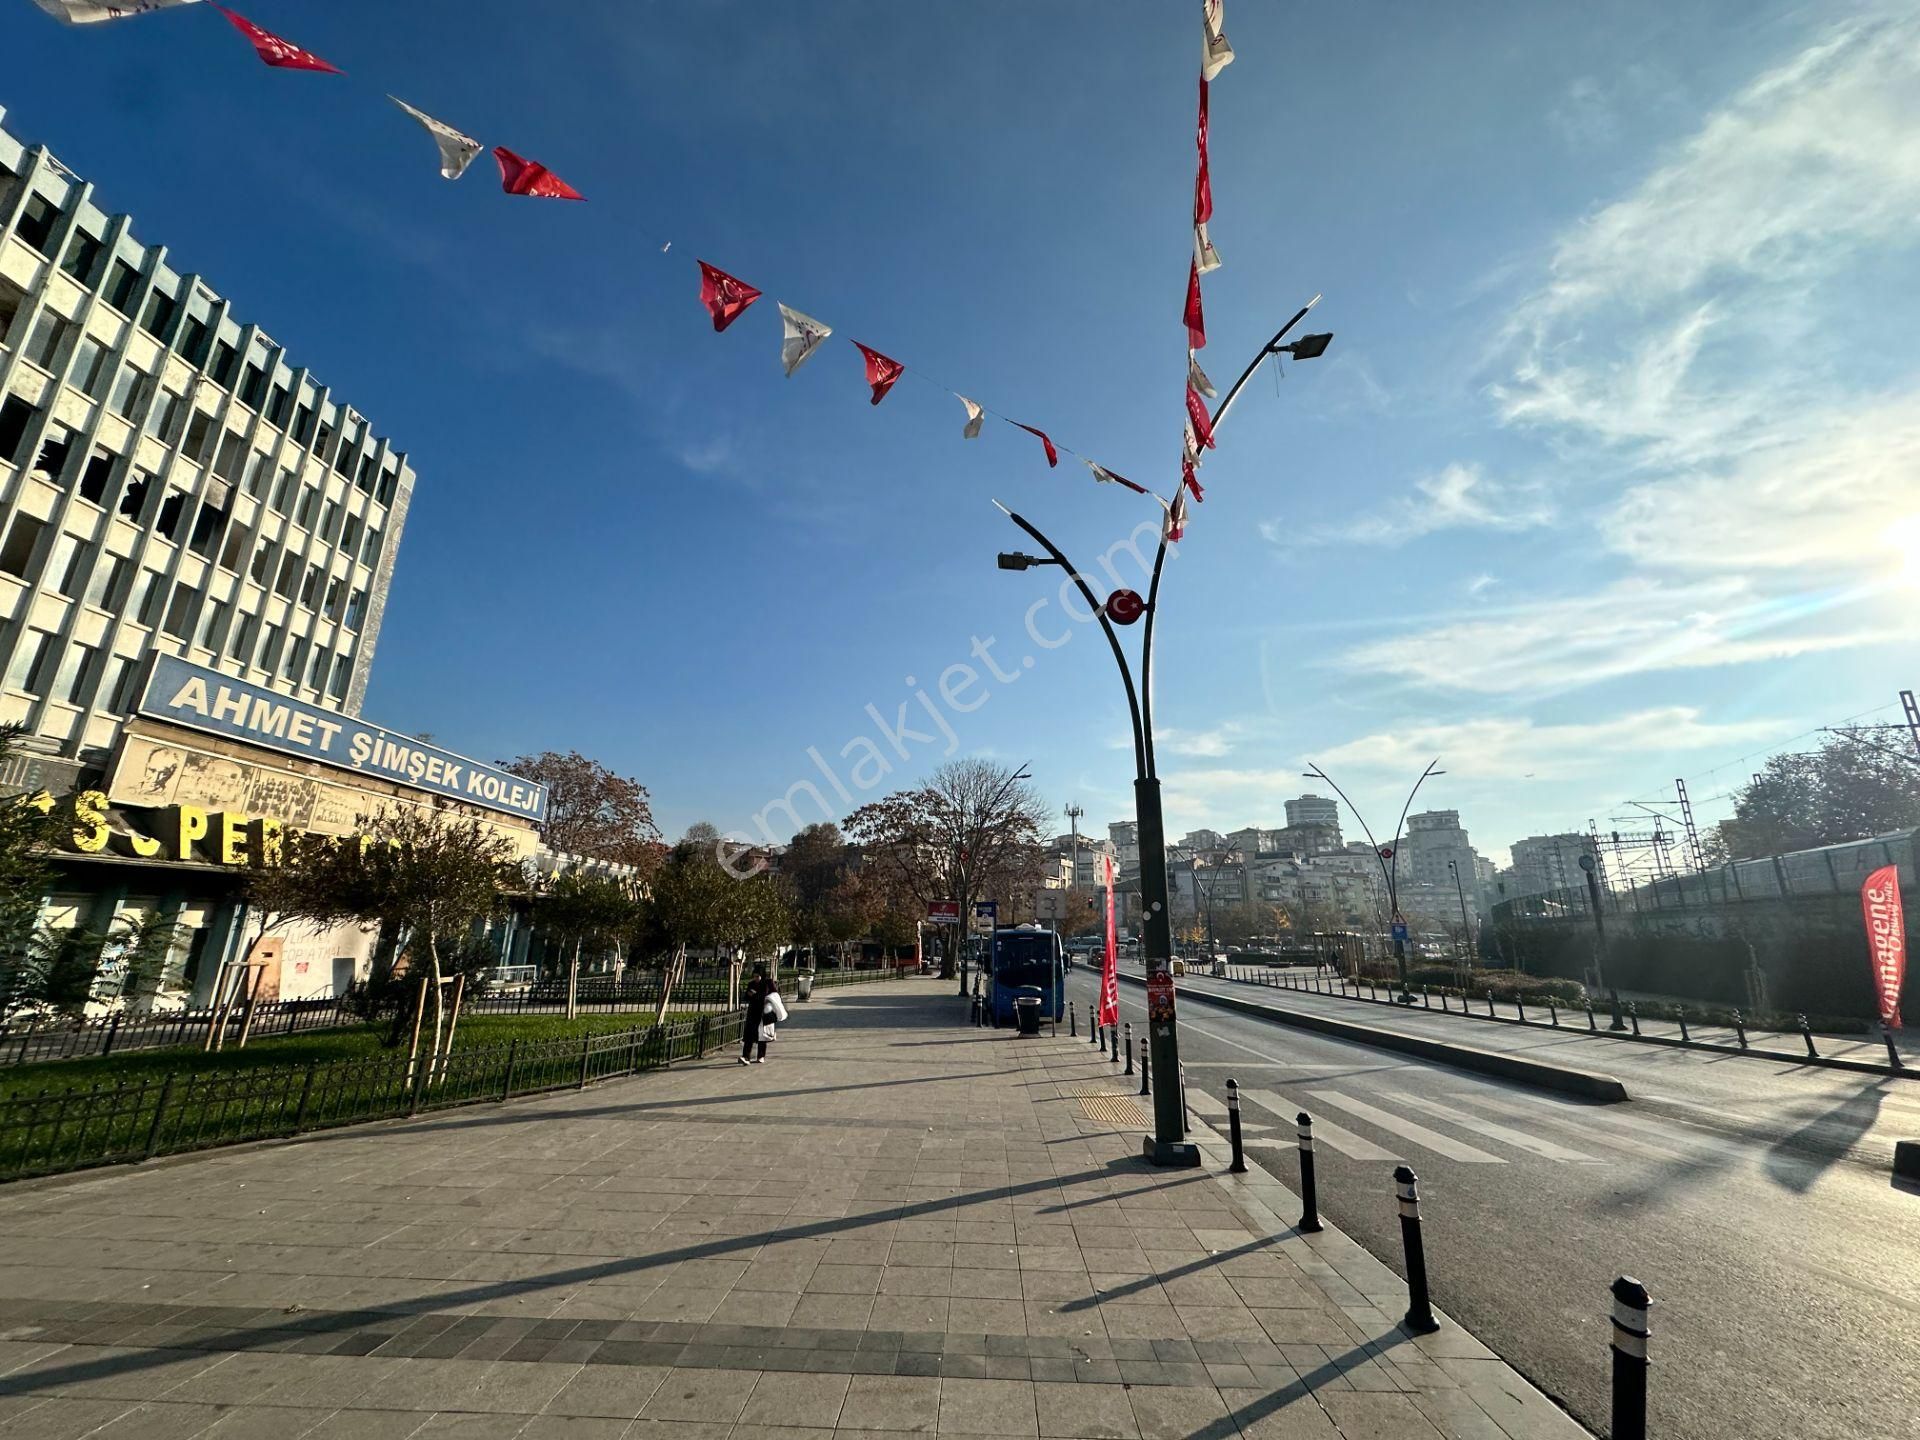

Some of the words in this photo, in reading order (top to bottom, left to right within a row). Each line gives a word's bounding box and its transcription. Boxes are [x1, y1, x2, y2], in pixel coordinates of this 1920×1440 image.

[168, 676, 342, 752] AHMET
[349, 731, 463, 790] ŞİMŞEK
[466, 770, 541, 813] KOLEJİ
